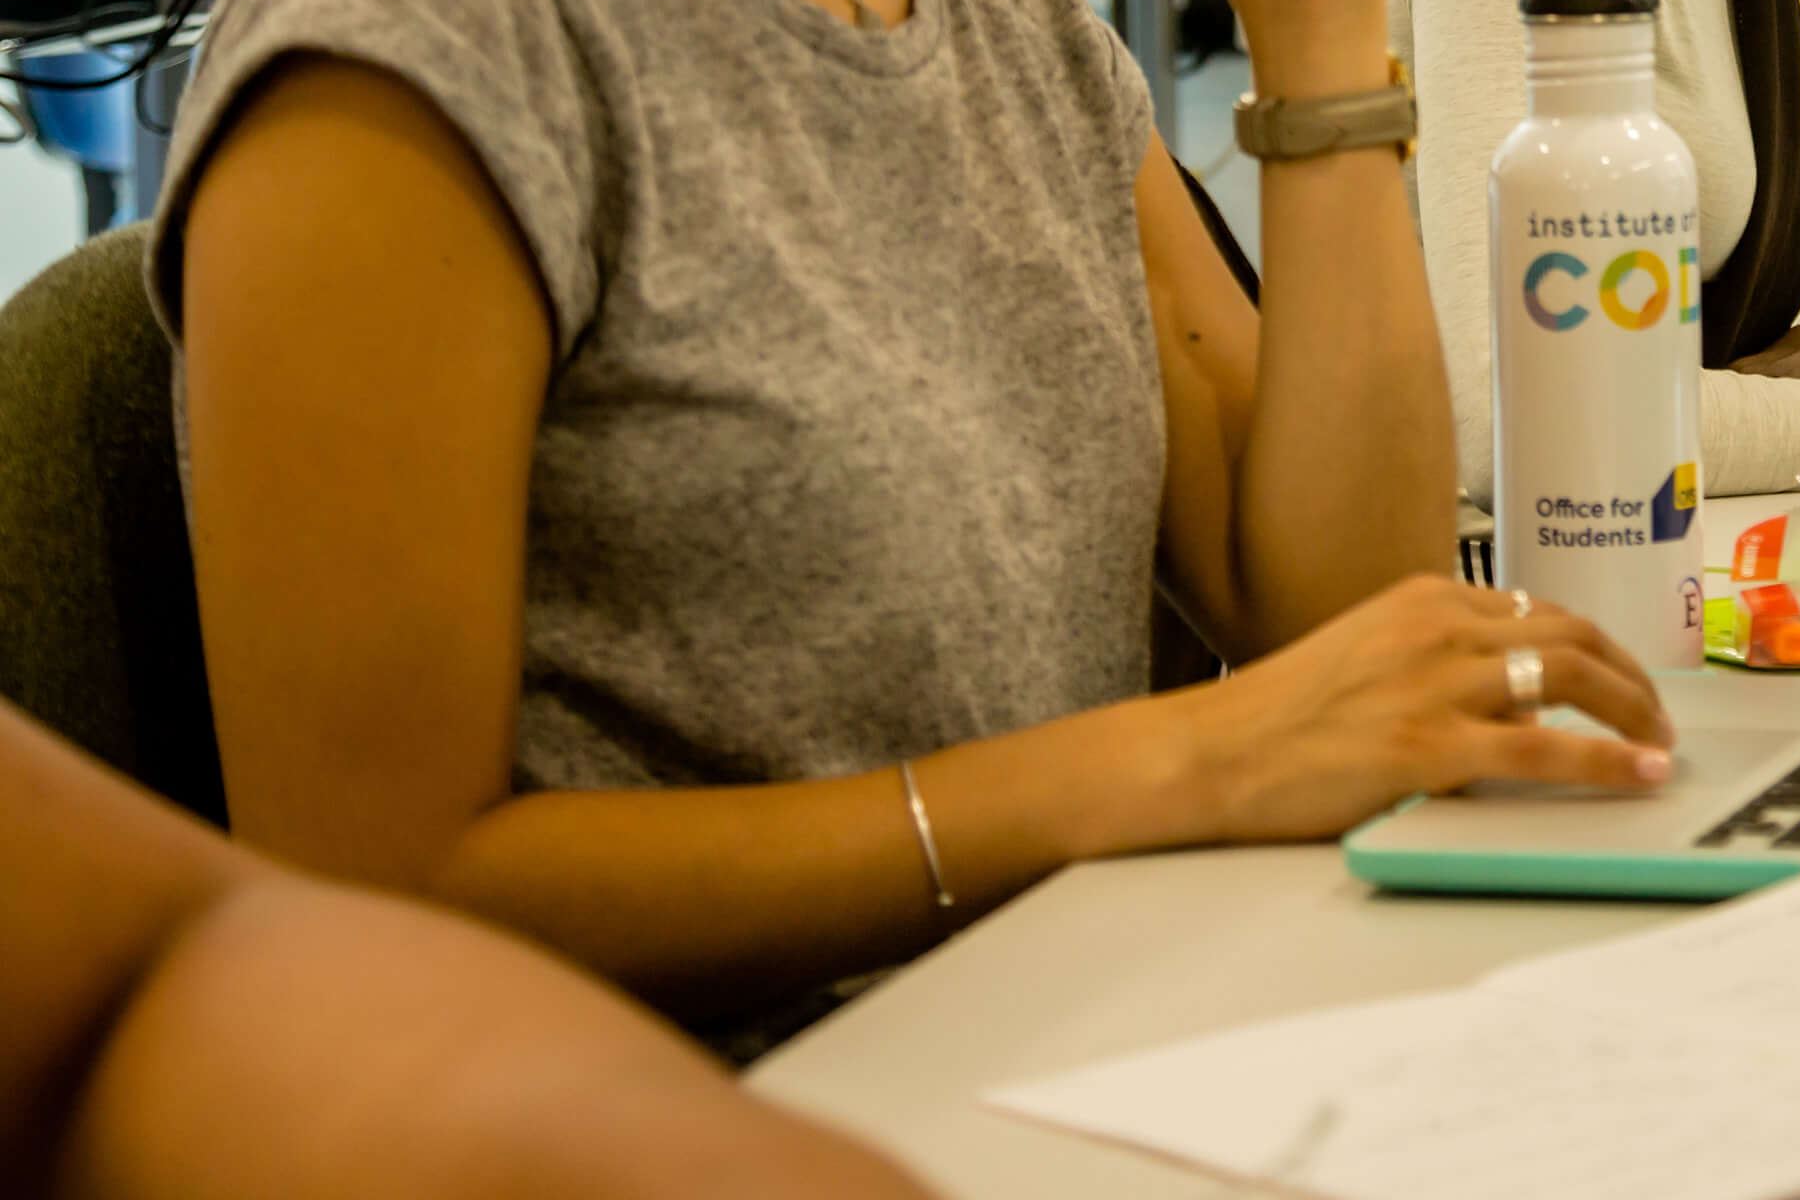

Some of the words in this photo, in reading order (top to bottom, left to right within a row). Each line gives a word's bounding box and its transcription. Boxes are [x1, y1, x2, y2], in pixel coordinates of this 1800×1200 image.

[1527, 211, 1676, 238] institute
[1536, 497, 1605, 518] Office
[1610, 497, 1645, 518] for
[1537, 526, 1646, 548] Students
